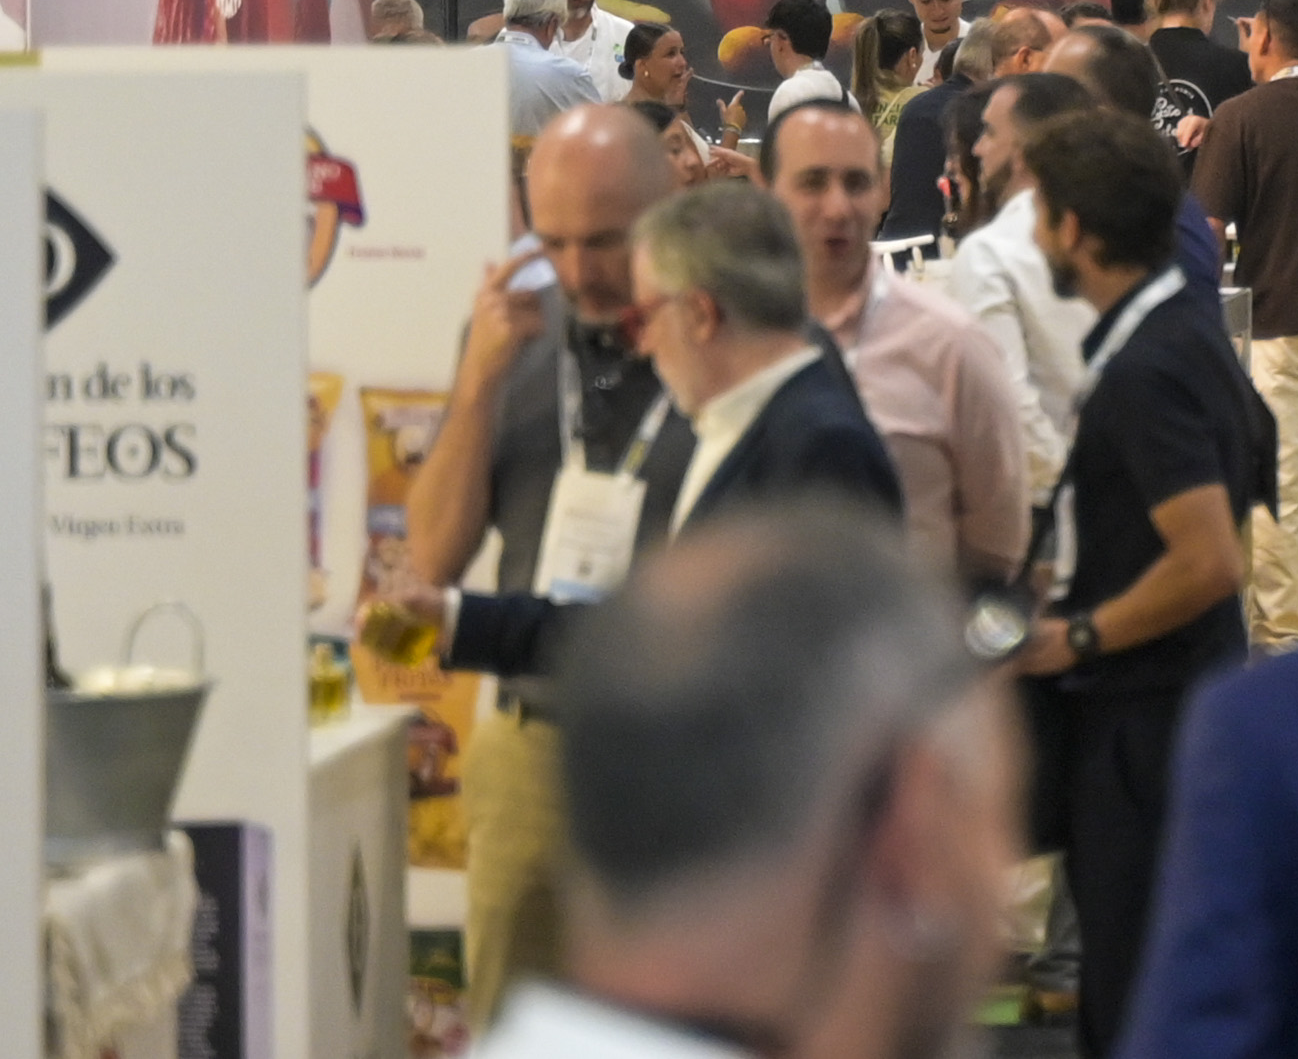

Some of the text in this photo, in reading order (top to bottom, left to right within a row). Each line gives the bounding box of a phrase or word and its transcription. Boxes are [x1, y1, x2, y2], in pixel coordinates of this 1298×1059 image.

[84, 360, 132, 402] de
[139, 359, 197, 402] los
[50, 514, 187, 540] Virgen Extra
